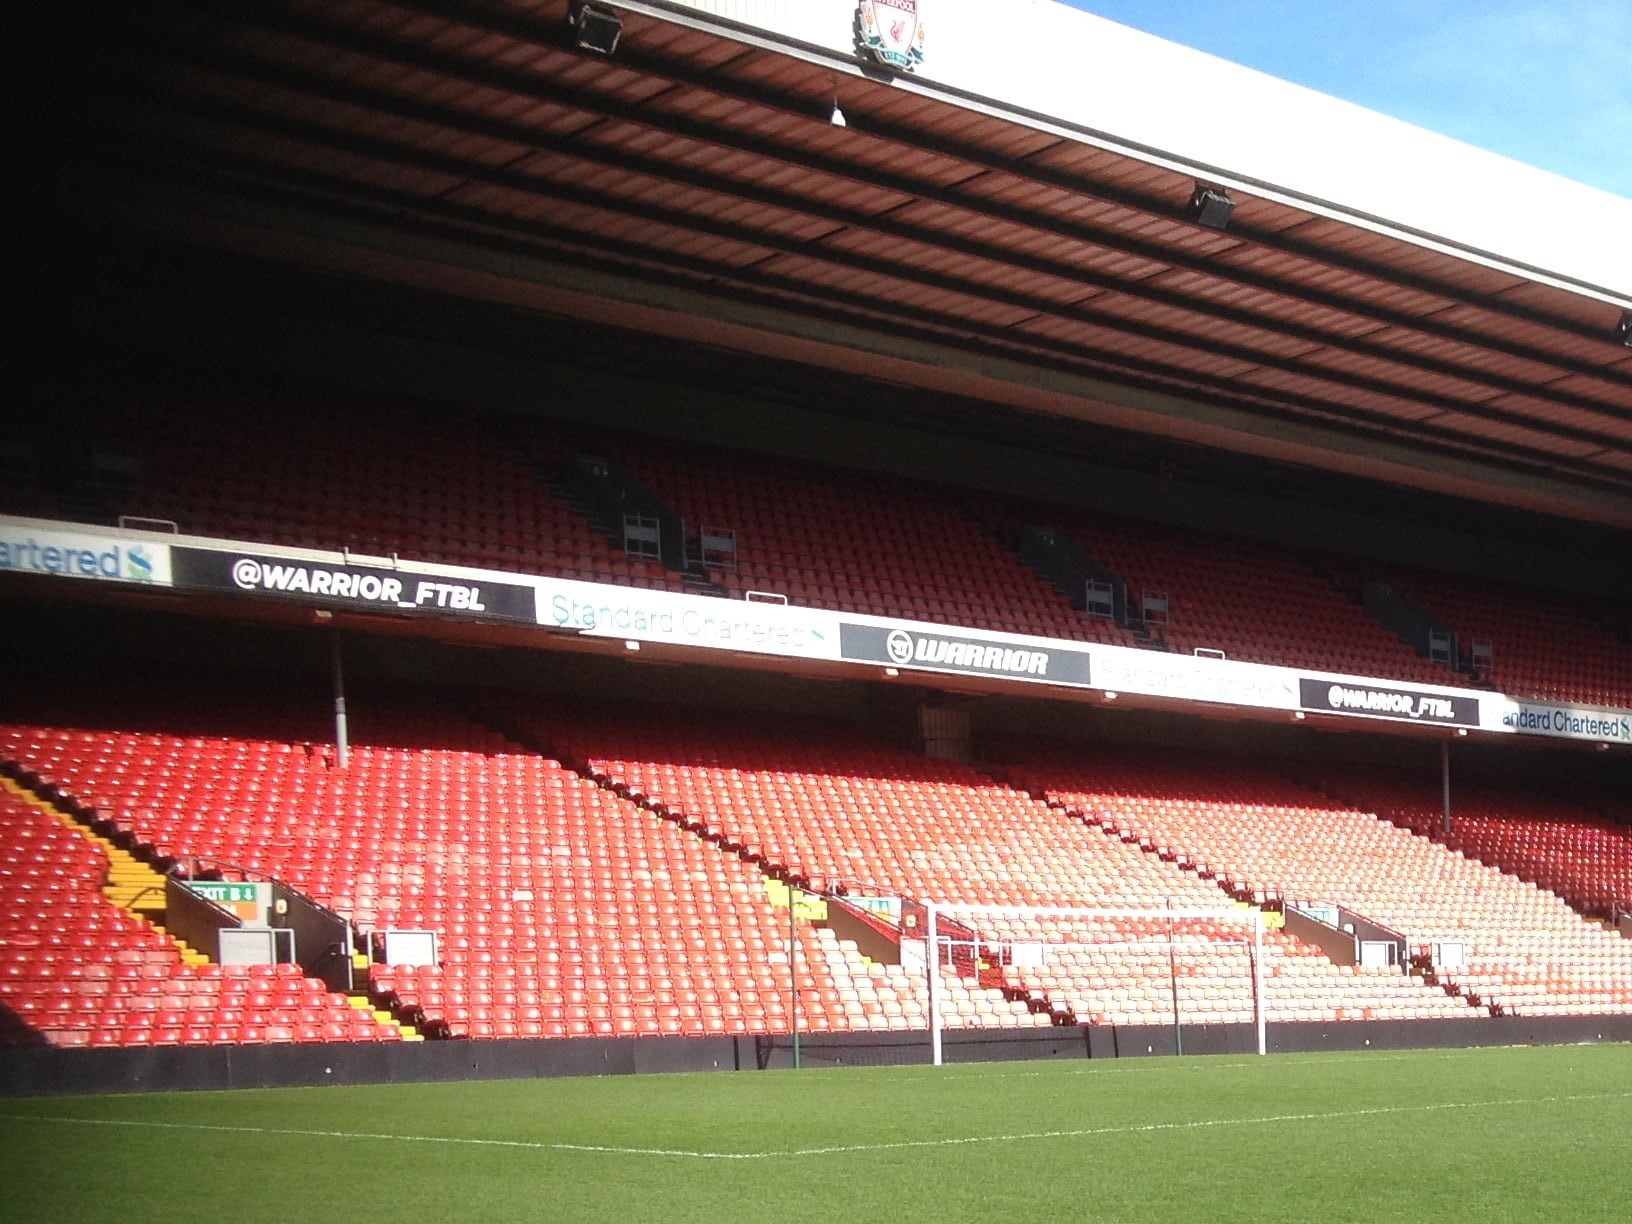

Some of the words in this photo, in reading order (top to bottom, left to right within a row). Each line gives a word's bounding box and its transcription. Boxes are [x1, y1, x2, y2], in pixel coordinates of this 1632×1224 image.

[232, 558, 485, 611] @WARRIOR_FTBL
[552, 594, 672, 632] Standard
[914, 637, 1049, 675] WARRIOR
[1492, 704, 1551, 731] andard
[1553, 710, 1619, 737] Chartered
